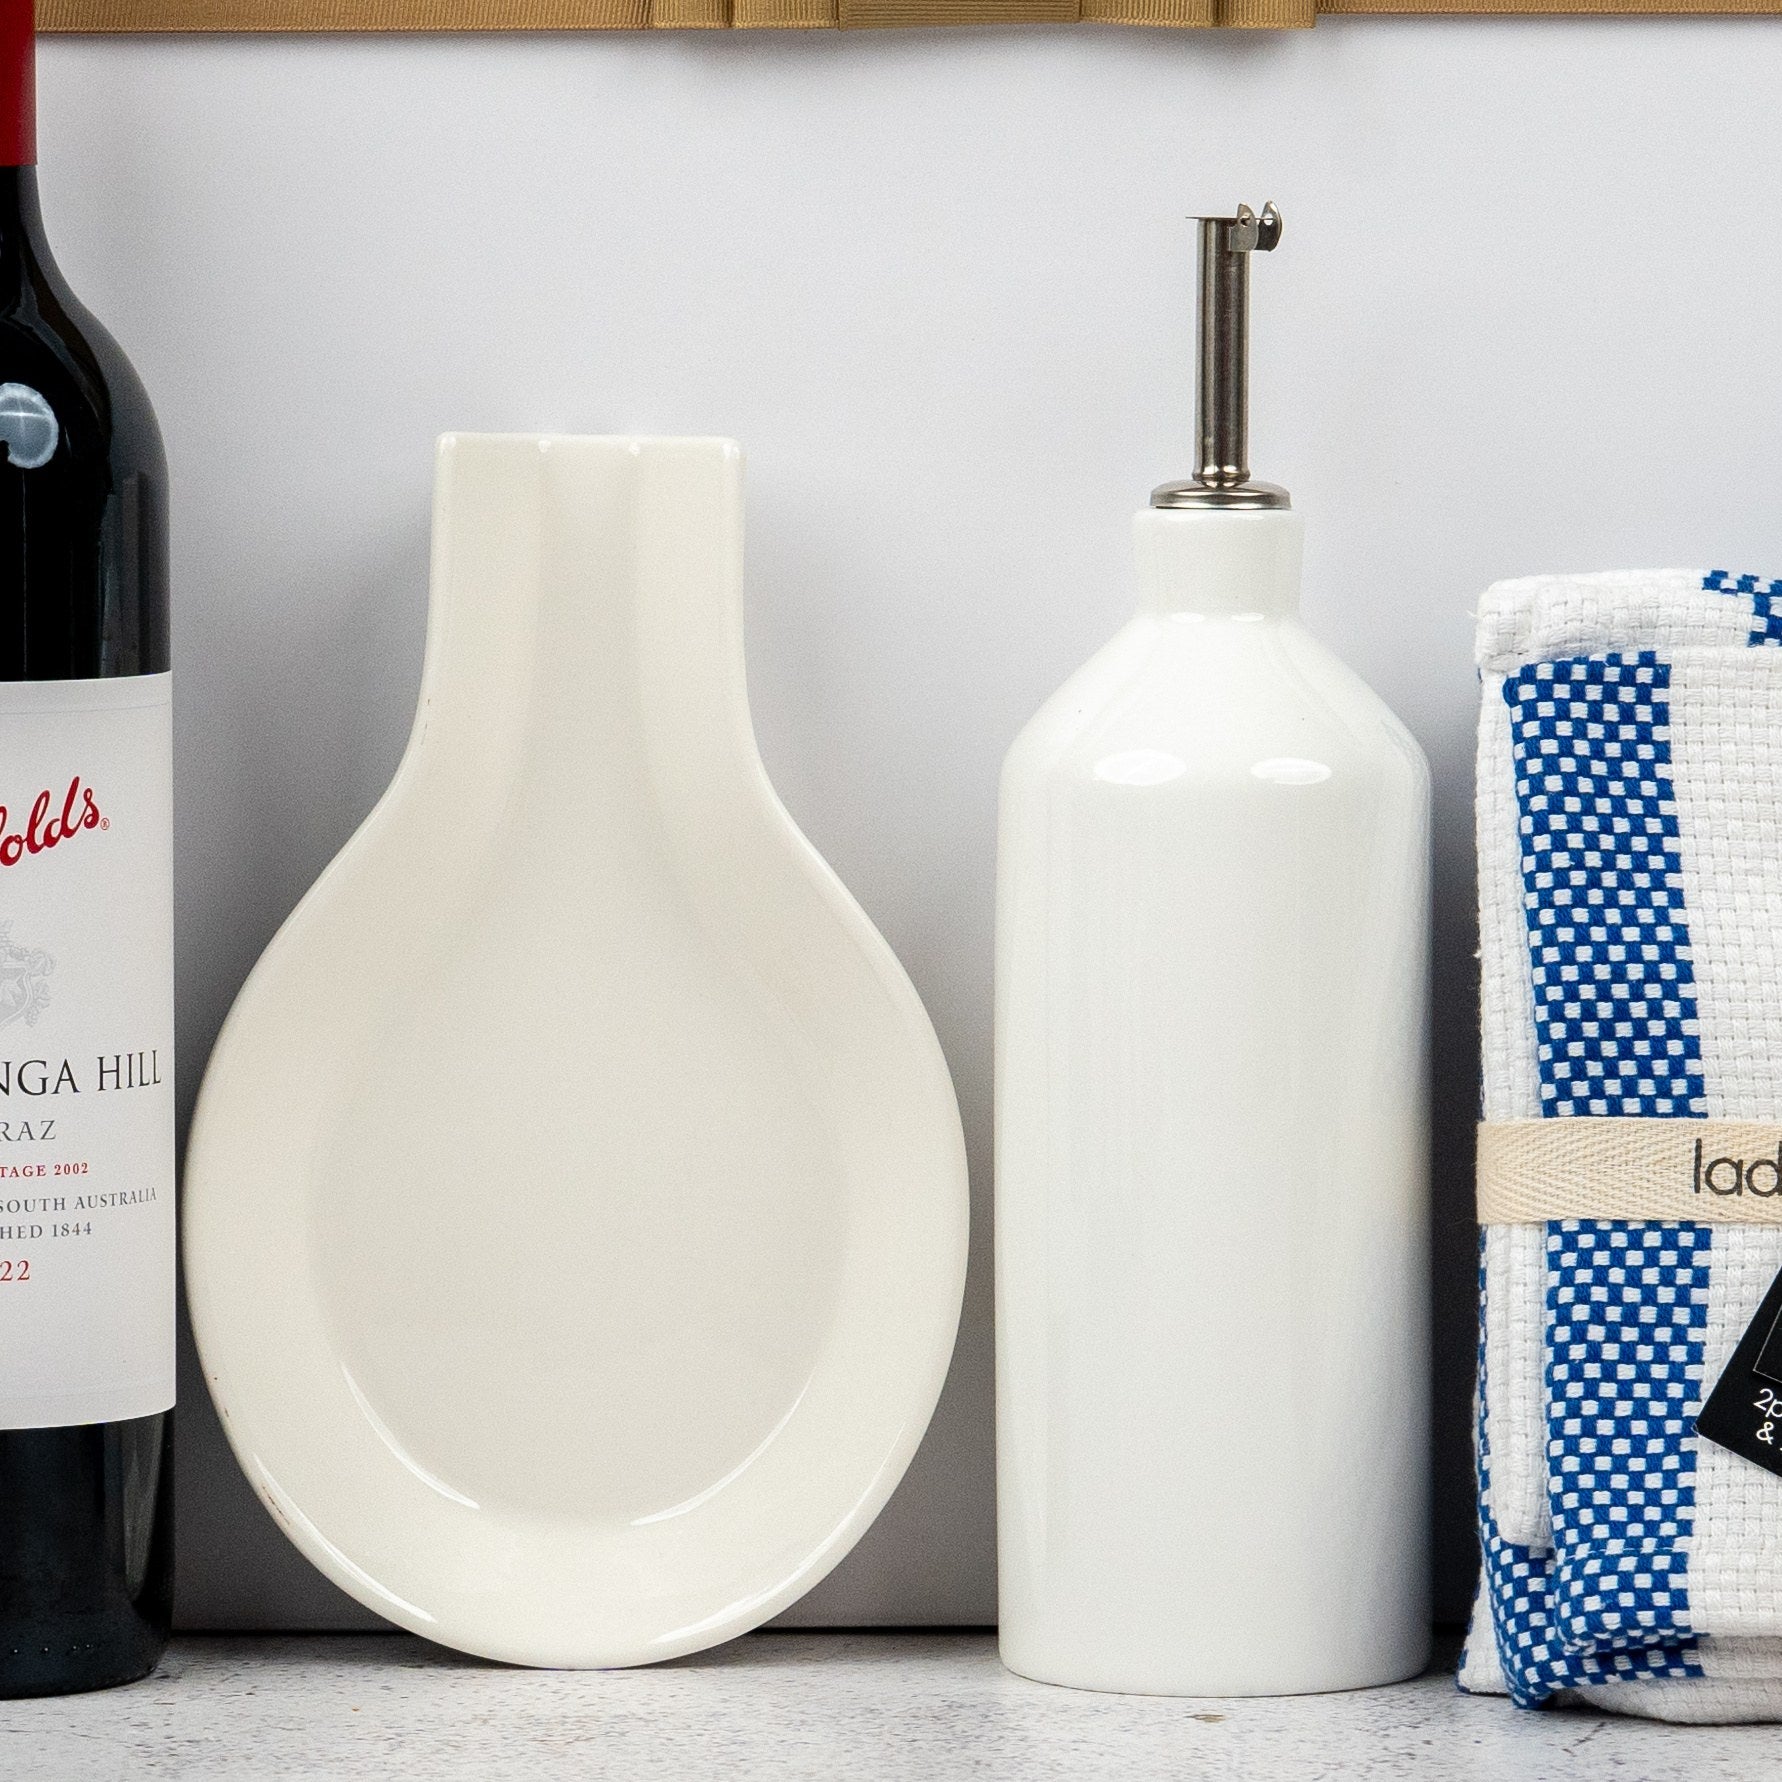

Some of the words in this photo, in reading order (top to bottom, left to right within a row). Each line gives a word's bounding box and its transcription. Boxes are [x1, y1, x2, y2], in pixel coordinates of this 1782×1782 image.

[0, 776, 100, 867] olds
[97, 1050, 161, 1091] HILL
[0, 1120, 56, 1142] RAZ
[0, 1164, 46, 1178] TAGE
[54, 1162, 88, 1176] 2002
[1694, 1138, 1782, 1197] lad
[0, 1197, 66, 1213] OUTH
[74, 1187, 157, 1210] AUSTRALIA
[0, 1224, 43, 1239] HED
[52, 1222, 91, 1238] 1844
[0, 1260, 30, 1281] 22
